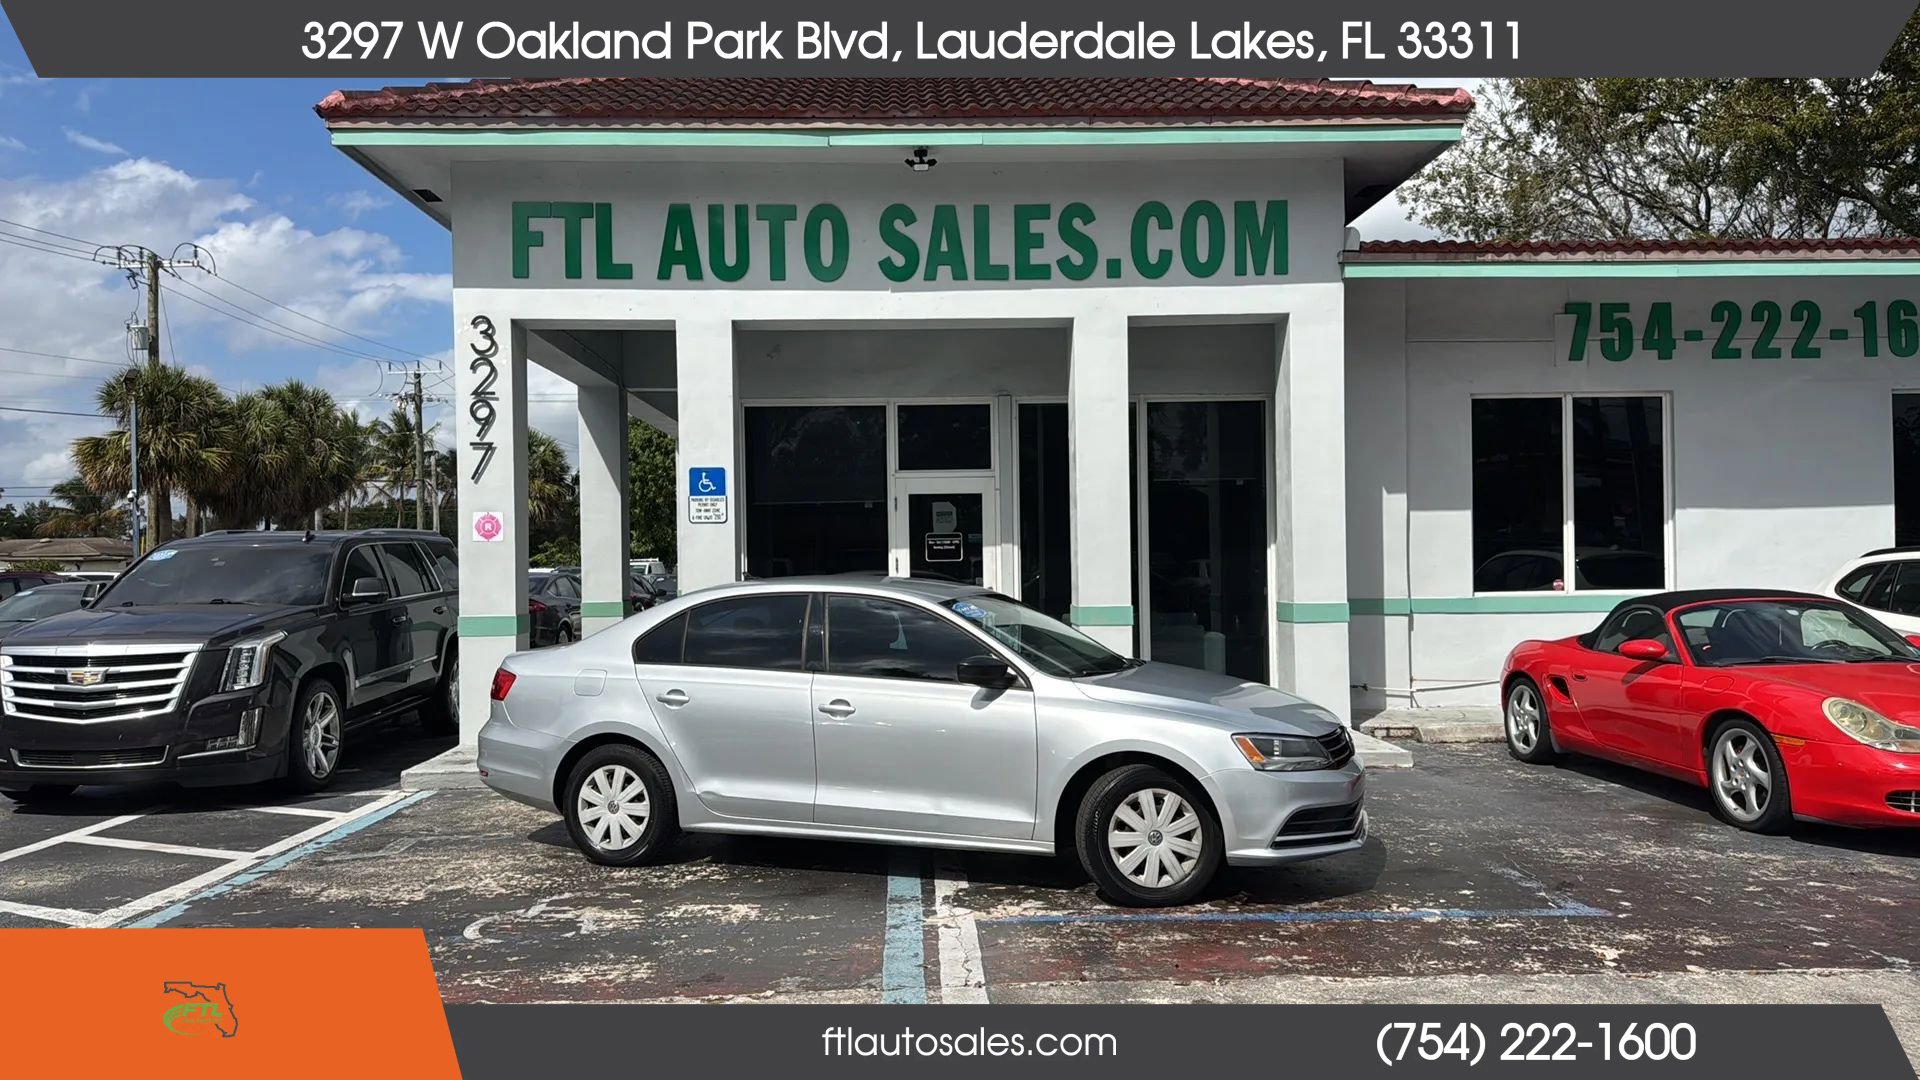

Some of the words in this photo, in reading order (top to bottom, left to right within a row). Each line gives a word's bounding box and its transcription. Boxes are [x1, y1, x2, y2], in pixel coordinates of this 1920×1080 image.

[511, 201, 634, 281] FTL
[657, 203, 850, 283] AUTO
[877, 199, 1290, 283] SALES.COM
[469, 314, 499, 485] 3297
